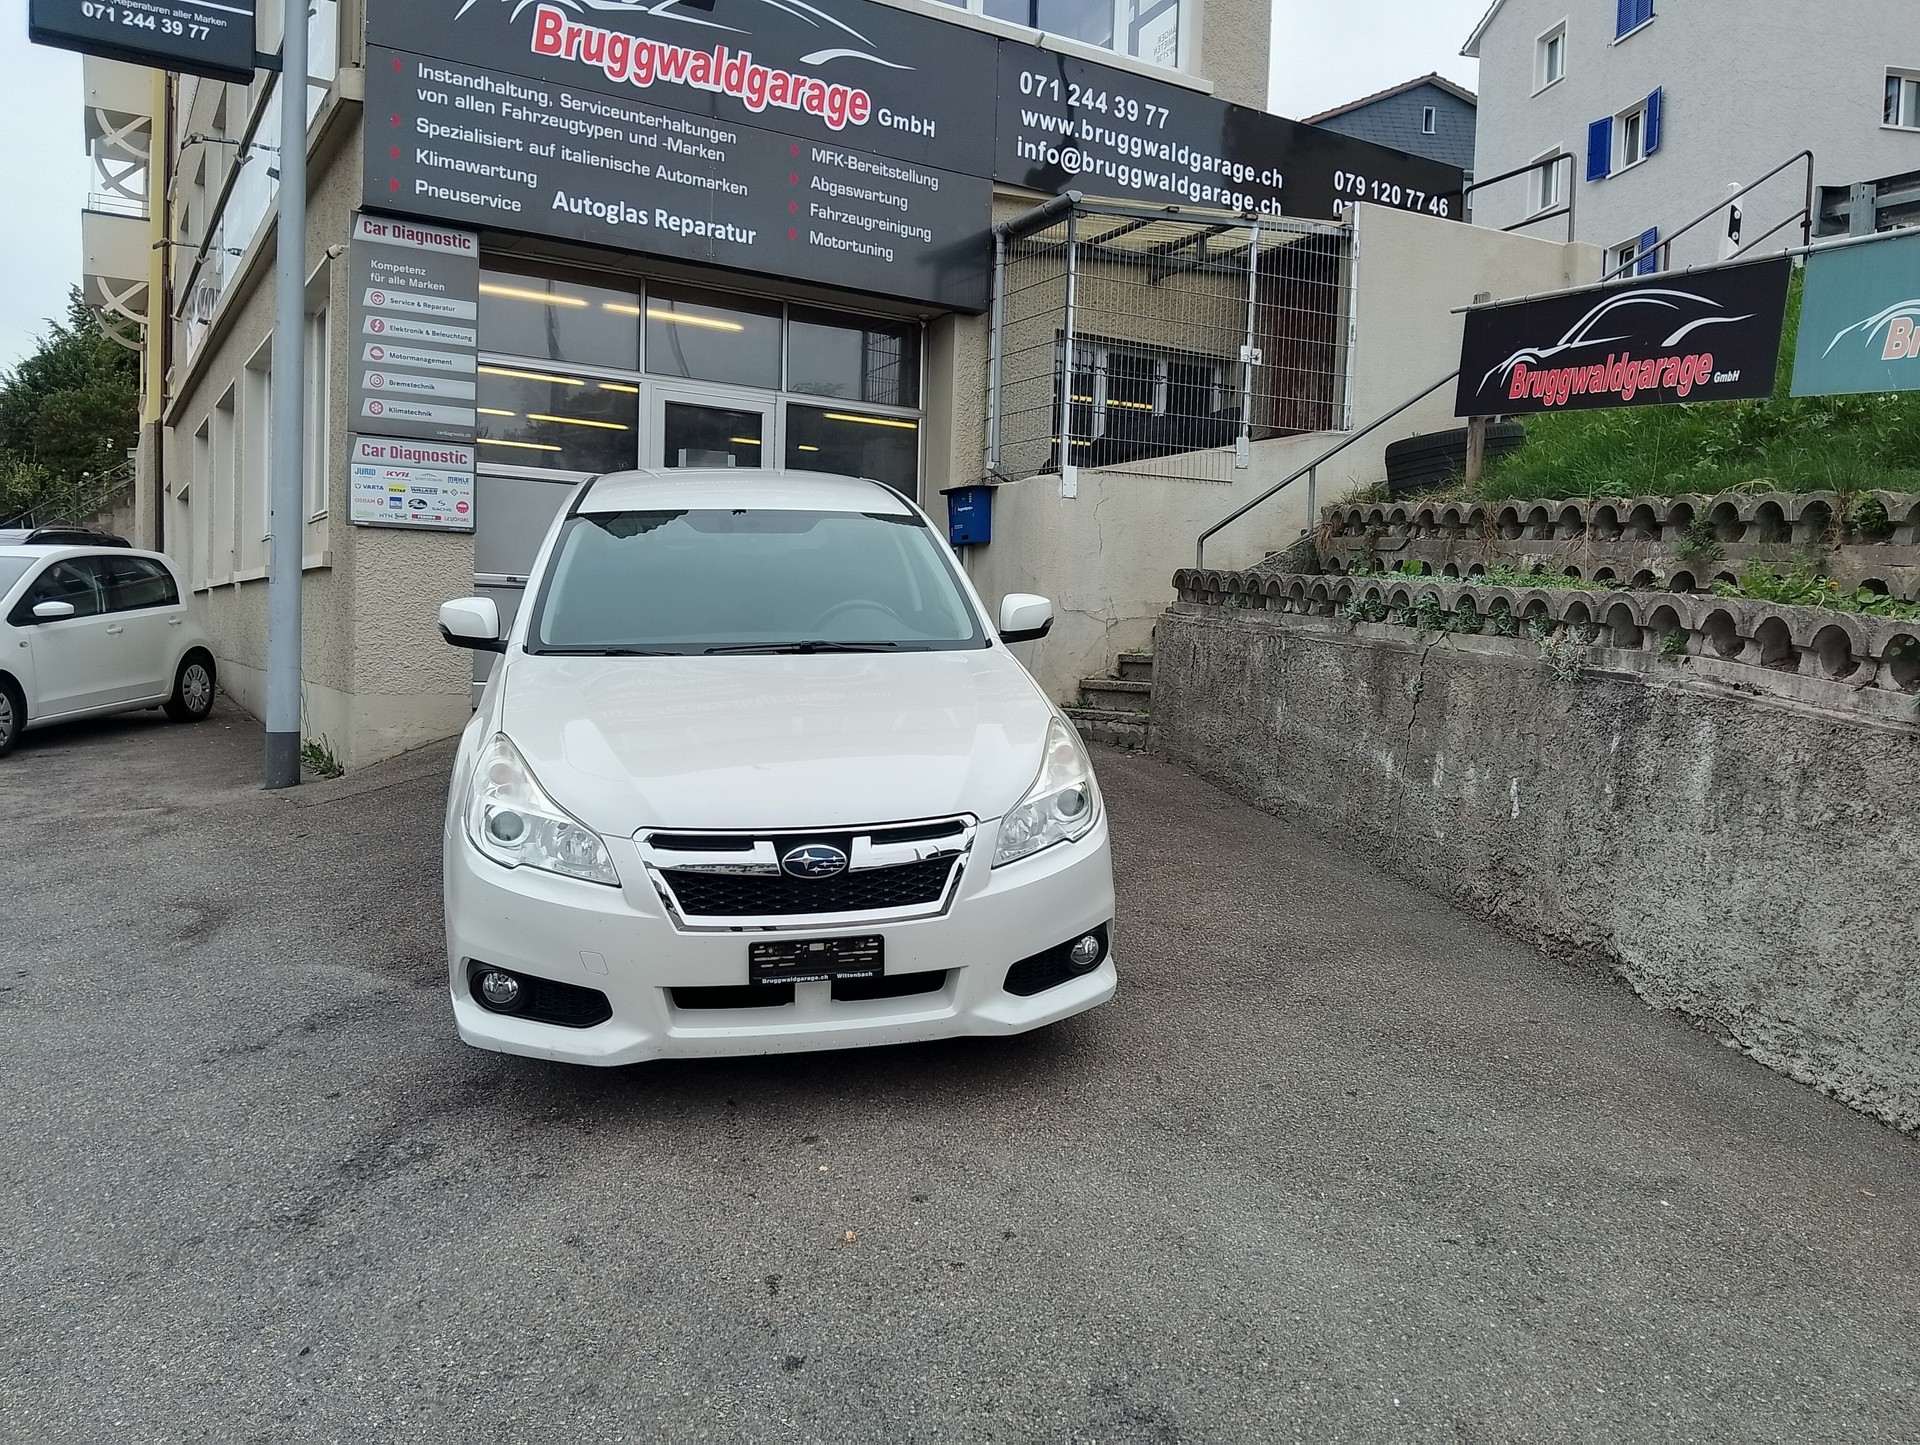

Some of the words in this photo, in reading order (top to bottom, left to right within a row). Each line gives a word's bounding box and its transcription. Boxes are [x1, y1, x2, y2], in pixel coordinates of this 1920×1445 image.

[81, 1, 115, 22] 071
[122, 10, 156, 31] 244
[160, 18, 183, 36] 39
[188, 23, 210, 41] 77
[172, 9, 192, 20] aller
[194, 13, 228, 28] Marken
[531, 4, 871, 130] Bruggwaldgarage
[878, 108, 936, 138] GmbH
[417, 62, 554, 108] Instandhaltung,
[559, 92, 737, 145] Serviceunterhaltungen
[1019, 70, 1059, 102] 071
[1067, 82, 1108, 115] 244
[1113, 95, 1139, 123] 39
[1144, 103, 1170, 130] 77
[417, 88, 449, 106] von
[454, 92, 496, 115] allen
[500, 102, 623, 141] Fahrzeugtypen
[628, 126, 658, 149] und
[660, 137, 726, 163] -Marken
[416, 117, 524, 153] Spezialisiert
[528, 141, 556, 159] auf
[560, 144, 651, 178] italienische
[655, 164, 749, 197] Automarken
[1020, 105, 1283, 190] www.bruggwaldgarage.ch
[415, 147, 538, 189] Klimawartung
[811, 147, 940, 191] MFK-Bereitstellung
[1017, 135, 1283, 217] info@bruggwaldgarage.ch
[810, 175, 909, 211] Abgaswartung
[1333, 170, 1366, 197] 079
[1371, 180, 1401, 205] 120
[1406, 188, 1426, 211] 77
[1428, 195, 1449, 217] 46
[415, 179, 522, 213] Pneuservice
[550, 190, 649, 226] Autoglas
[654, 208, 757, 246] Reparatur
[809, 202, 933, 242] Fahrzeugreinigung
[363, 219, 389, 237] Car
[392, 224, 471, 250] Diagnostic
[808, 230, 894, 262] Motortuning
[369, 272, 385, 284] für
[388, 276, 406, 286] alle
[408, 278, 445, 292] Marken
[370, 259, 427, 277] Kompetenz
[389, 297, 416, 308] Service
[422, 302, 456, 313] Reparatur
[389, 324, 425, 336] Elektronik
[431, 330, 473, 343] Beleuchtung
[389, 352, 453, 366] Motormanagement
[388, 379, 436, 391] Bremstechnik
[1508, 352, 1714, 406] Bruggwaldgarage
[1713, 370, 1741, 384] GmbH
[388, 406, 433, 418] Klimatechnik
[354, 467, 376, 476] JURID
[361, 443, 386, 458] Car
[389, 446, 468, 465] Diagnostic
[762, 974, 829, 984] Bruggwaldgarage.ch
[836, 971, 873, 979] Wittenbach
